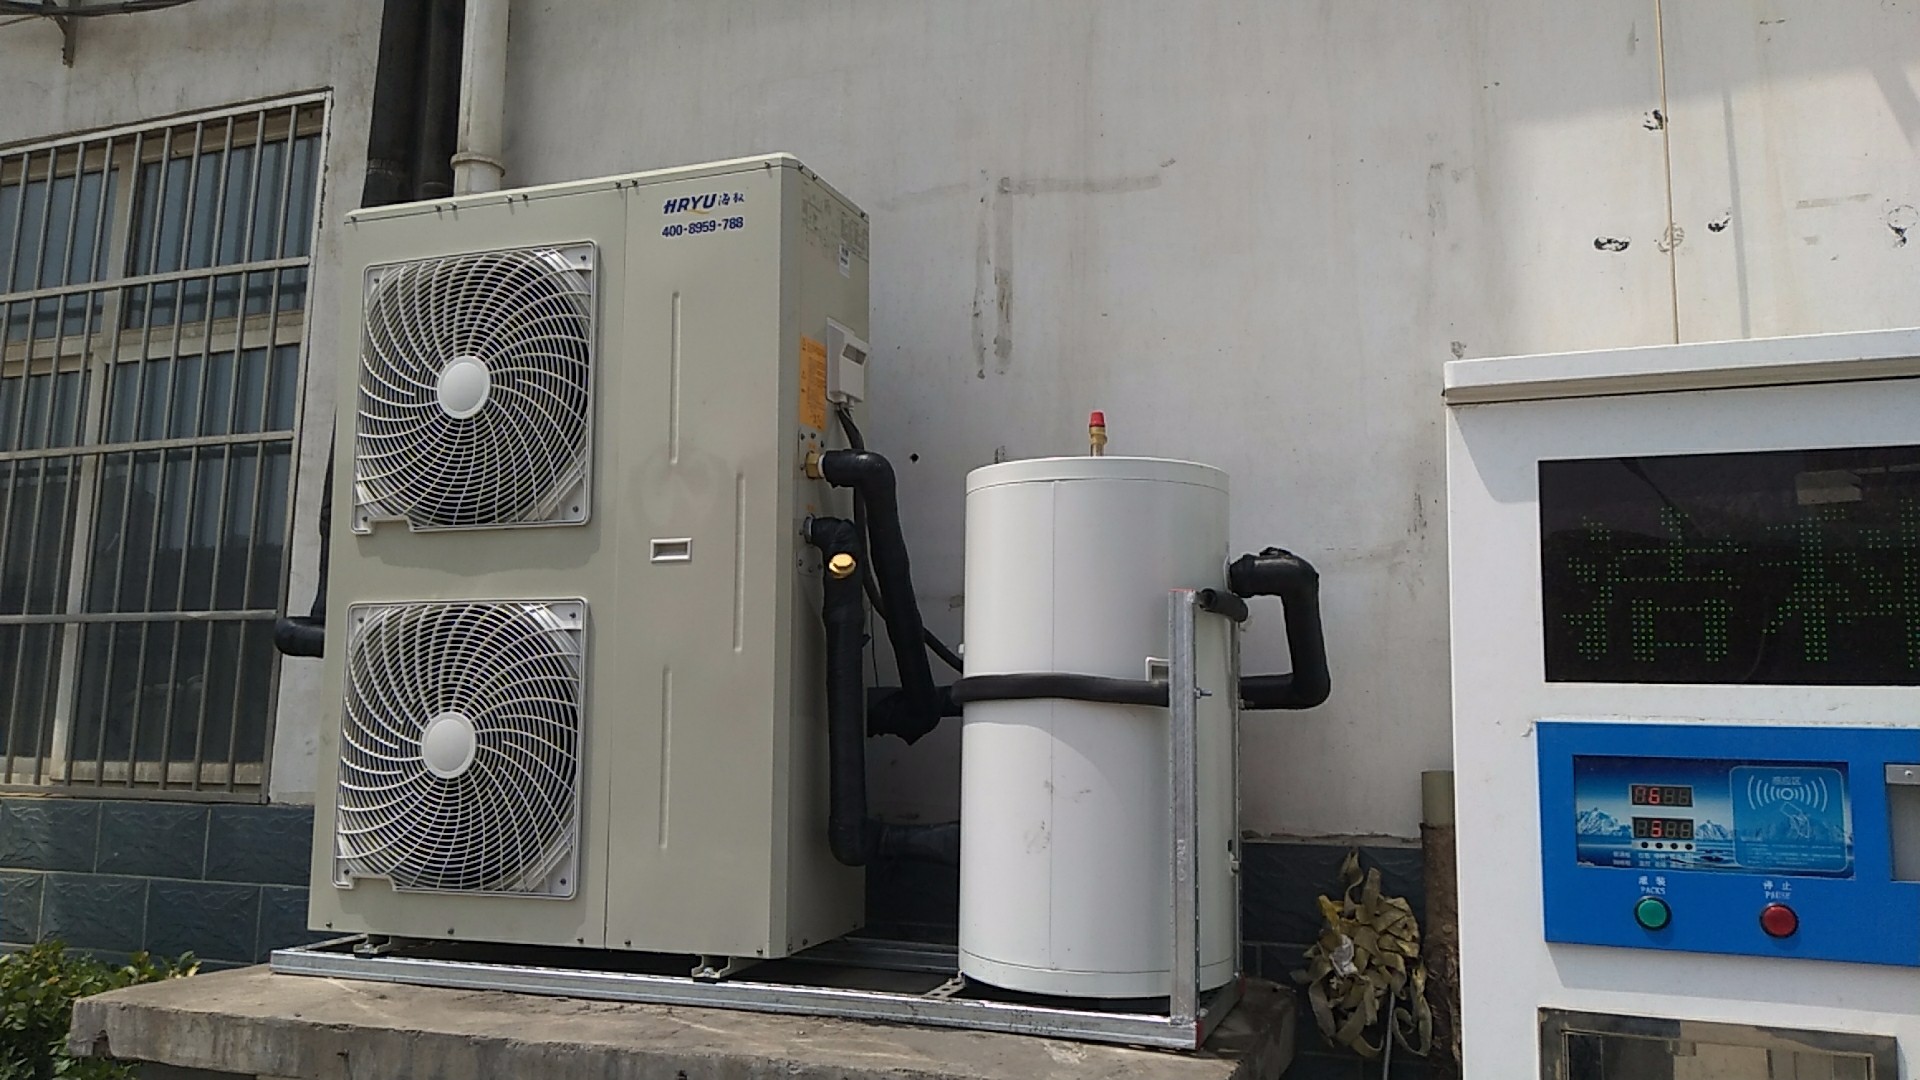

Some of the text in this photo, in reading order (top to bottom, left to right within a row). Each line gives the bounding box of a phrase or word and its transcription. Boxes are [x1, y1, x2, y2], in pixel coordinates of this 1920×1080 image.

[664, 194, 717, 214] HRYU
[662, 217, 743, 237] 400-8959-788
[1640, 886, 1666, 895] PACKS
[1762, 880, 1792, 891] 停止
